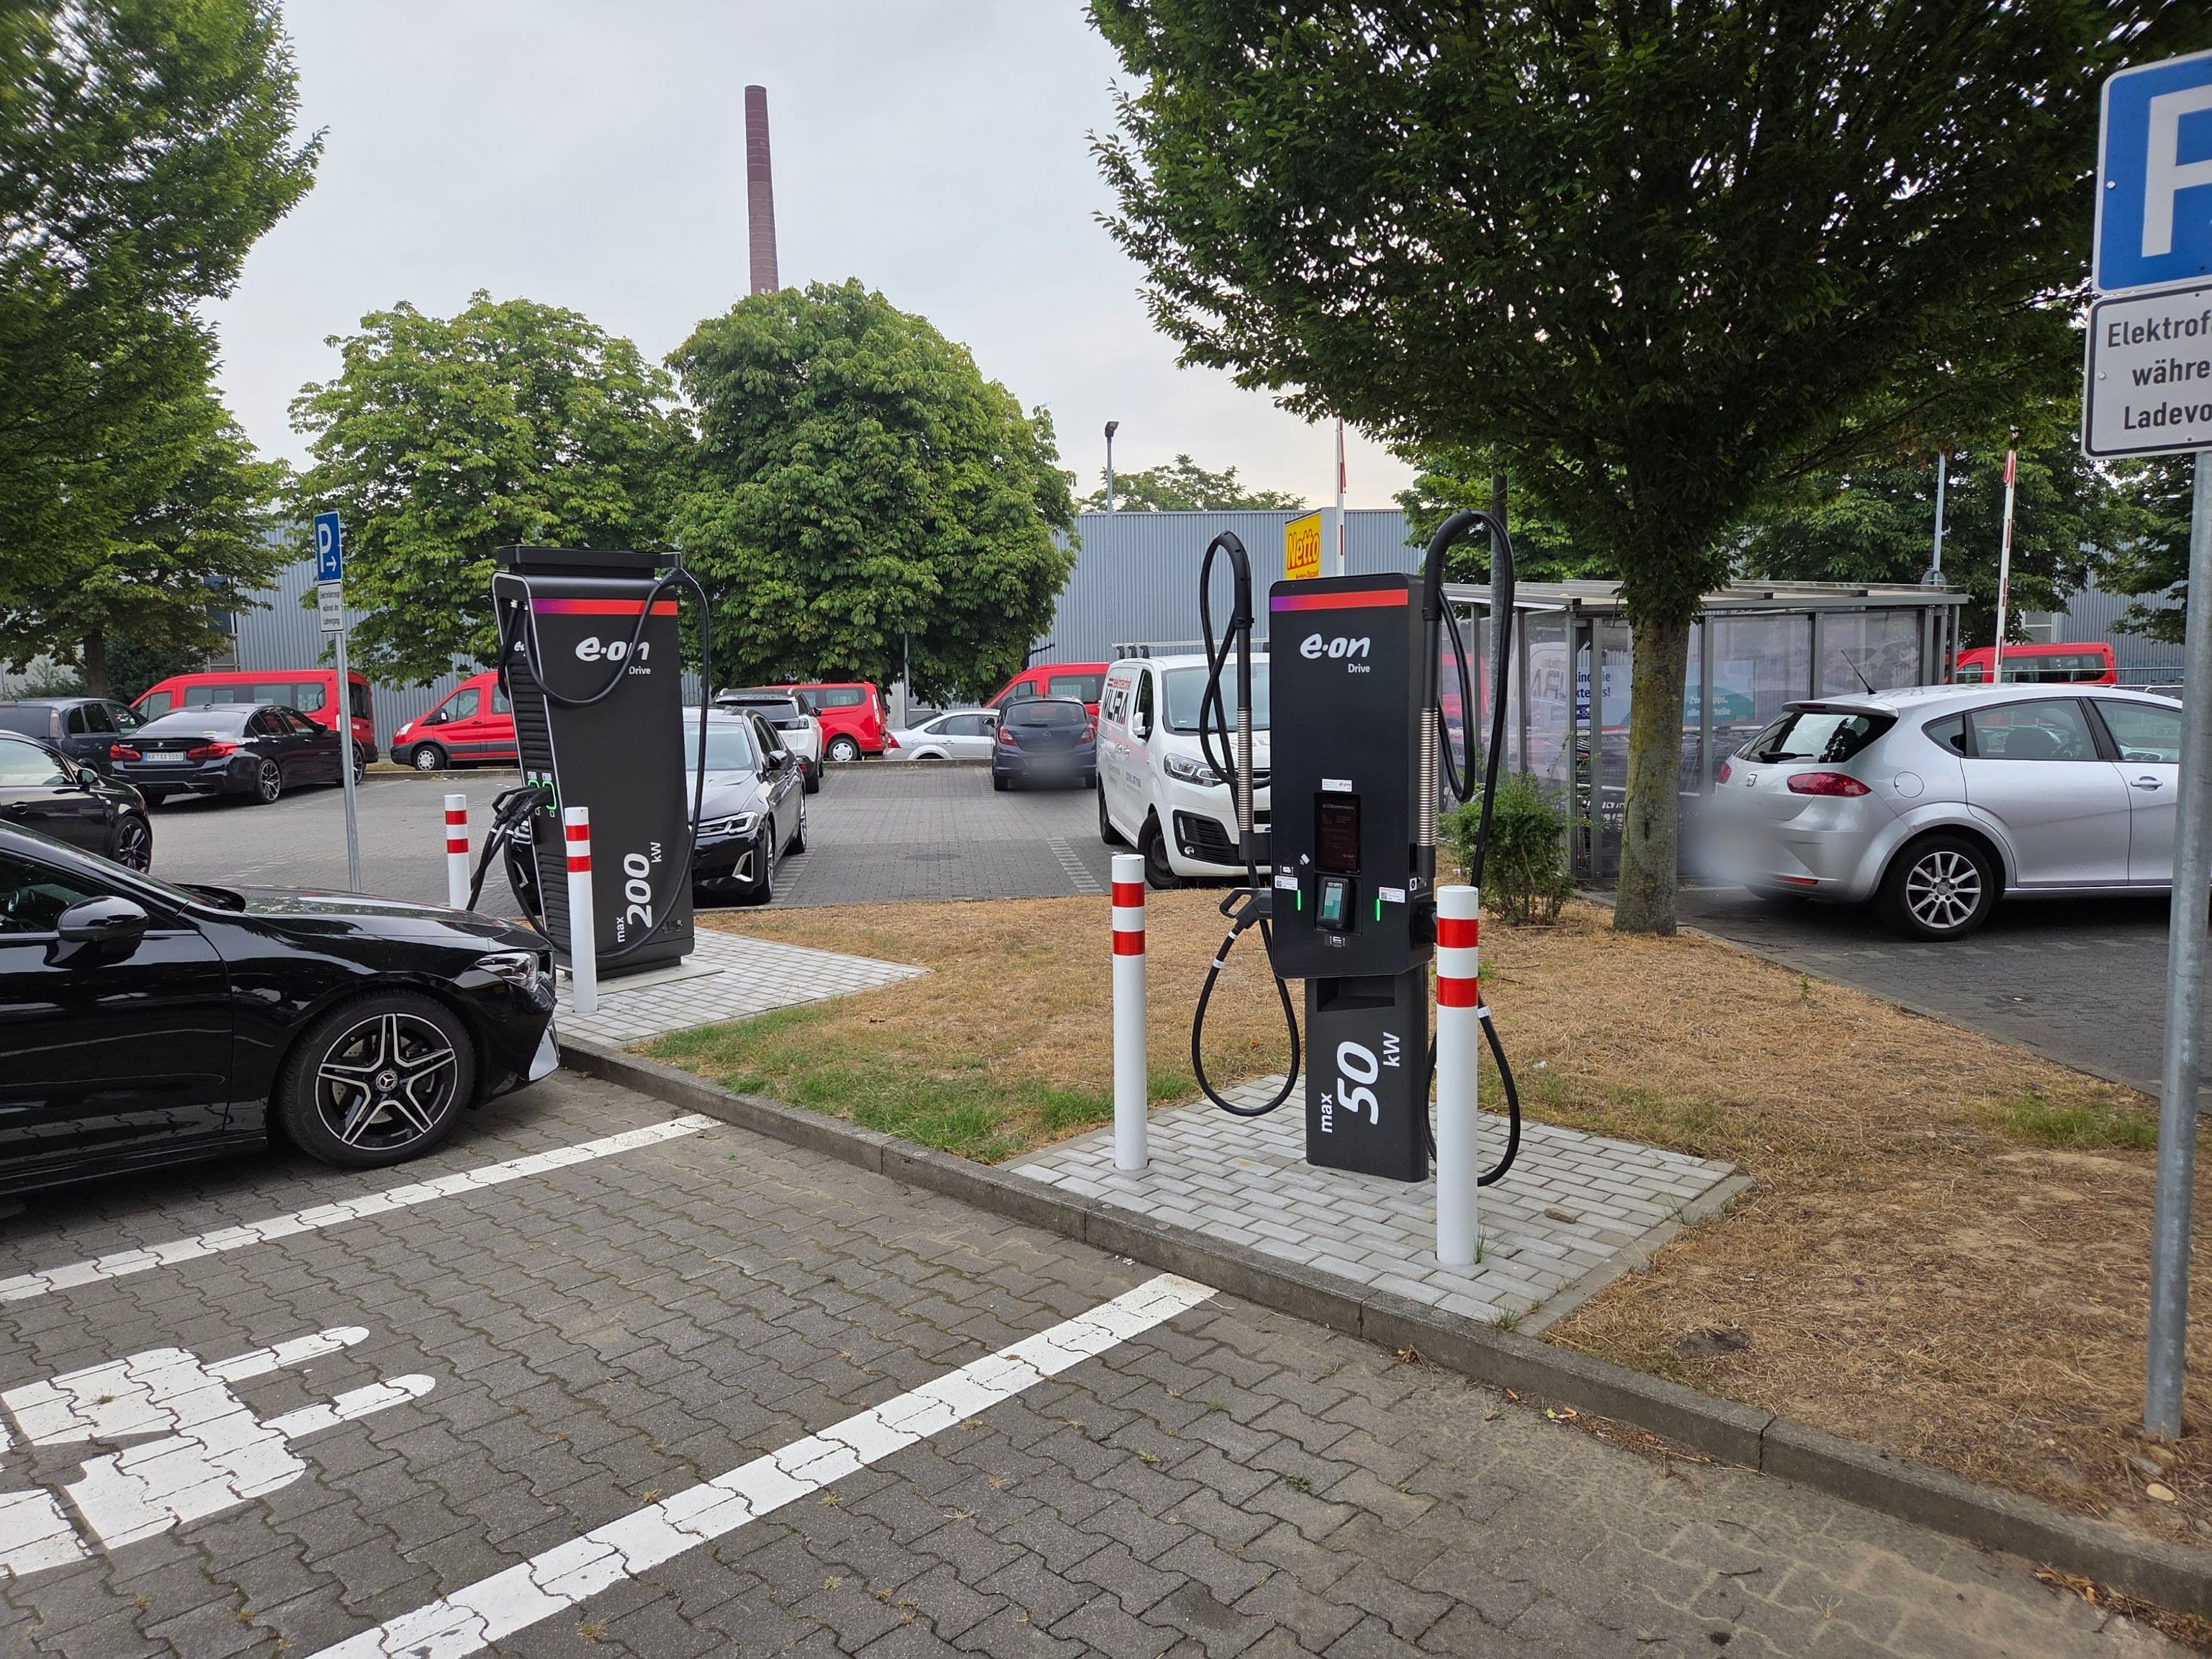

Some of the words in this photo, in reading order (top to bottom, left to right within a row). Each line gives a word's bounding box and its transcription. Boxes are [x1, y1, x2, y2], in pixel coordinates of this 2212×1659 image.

[2108, 309, 2212, 348] Elektrof
[318, 523, 332, 573] P
[1287, 529, 1319, 570] Netto
[629, 665, 651, 675] Drive
[1348, 663, 1371, 673] Drive
[616, 916, 625, 943] max
[624, 853, 652, 928] 200
[650, 842, 662, 863] kW
[1321, 1092, 1333, 1133] max
[1336, 1040, 1379, 1125] 50
[1382, 1031, 1400, 1067] kW
